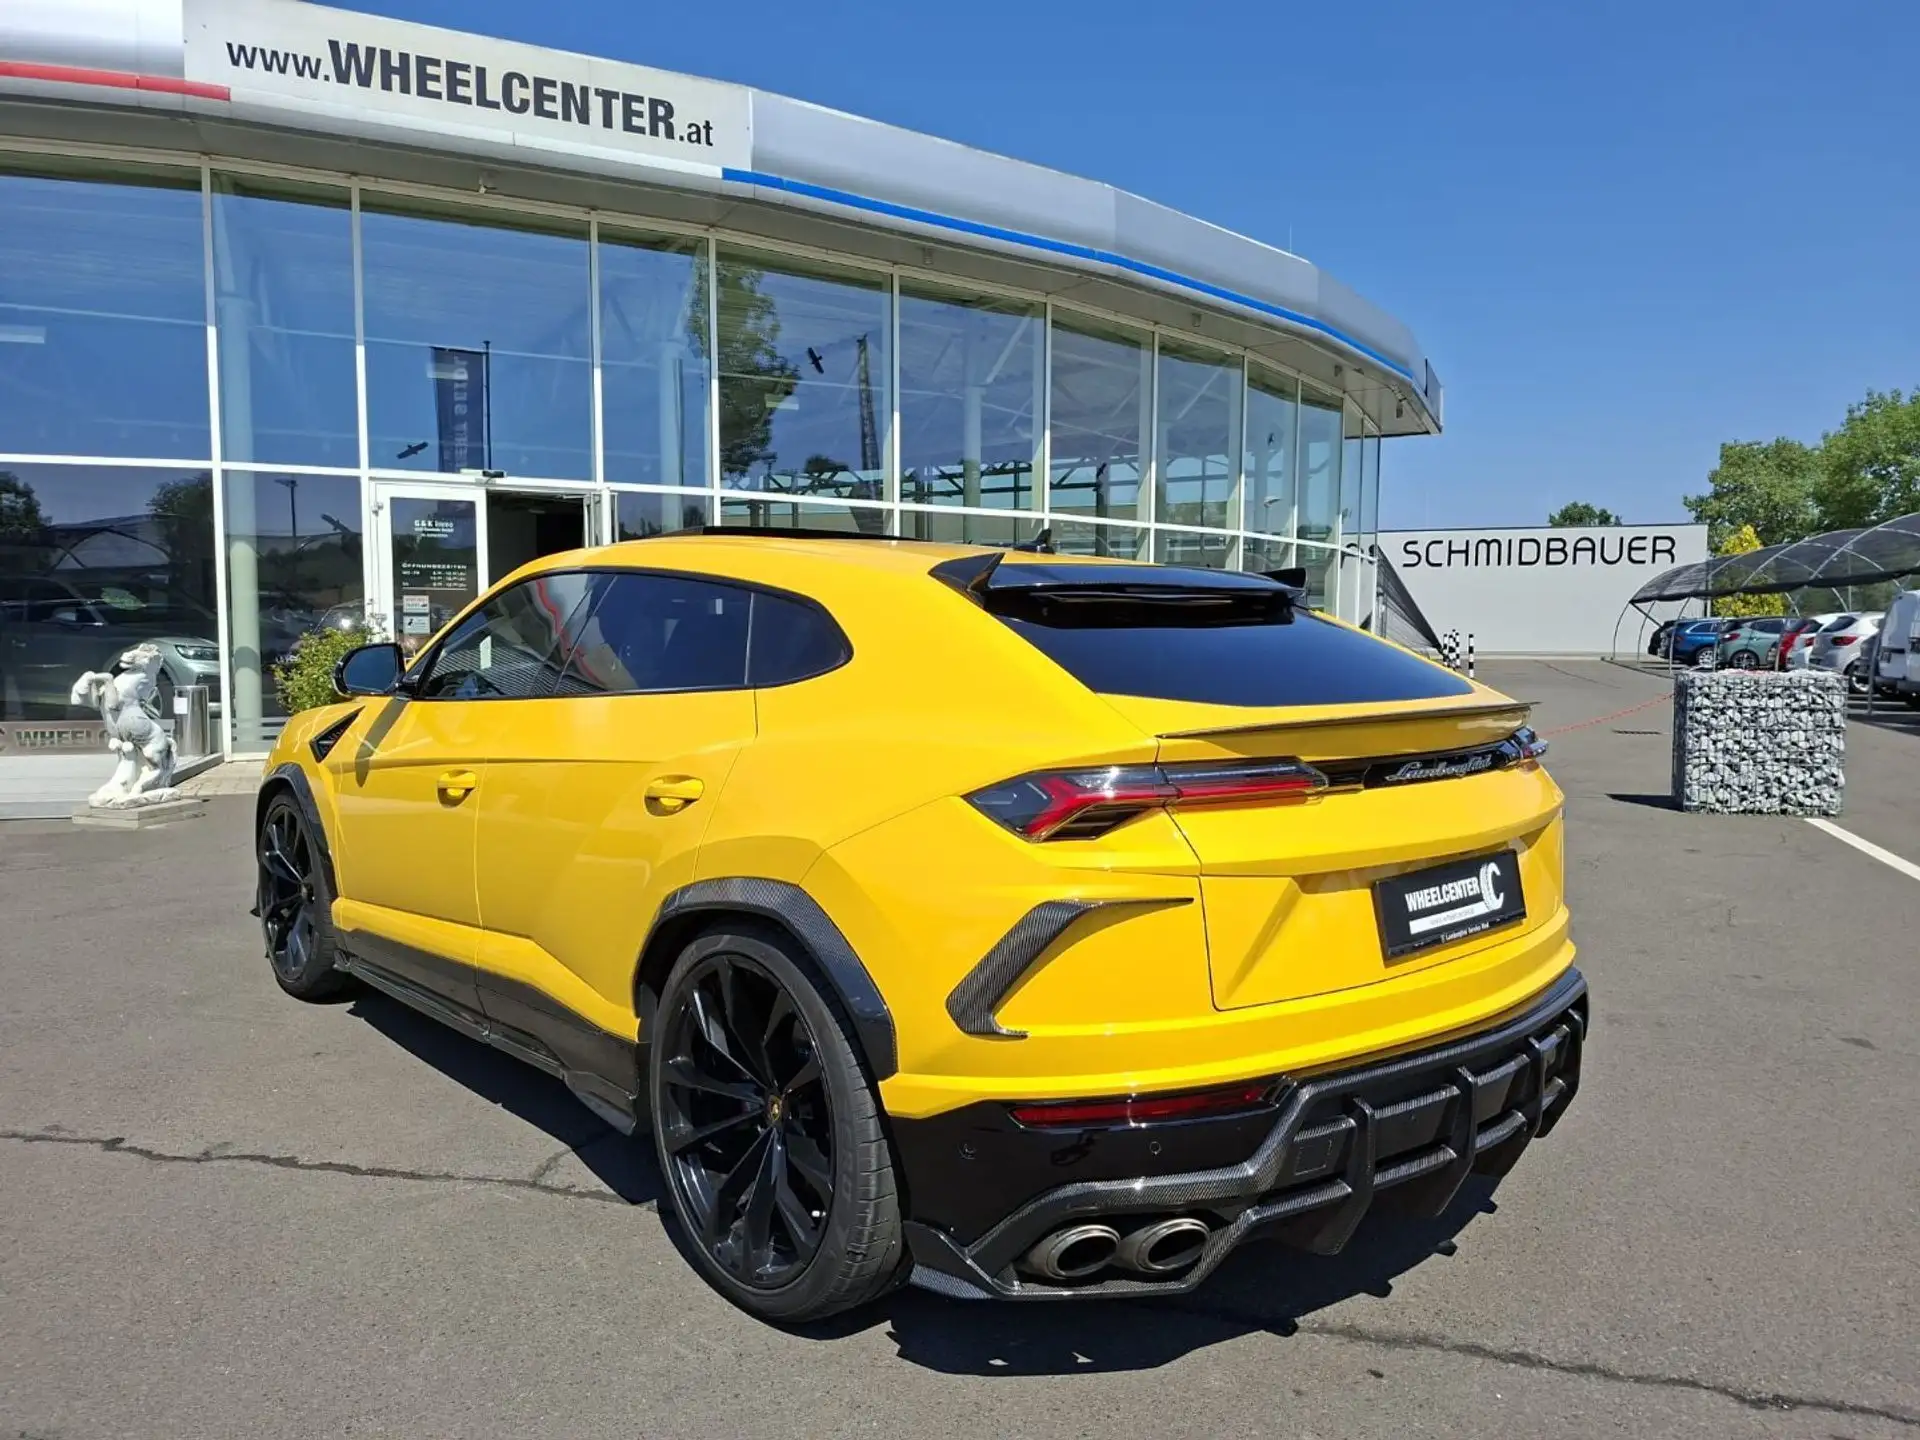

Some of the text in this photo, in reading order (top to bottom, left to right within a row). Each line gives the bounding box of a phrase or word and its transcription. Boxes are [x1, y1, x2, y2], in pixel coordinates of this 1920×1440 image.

[226, 39, 713, 147] www.WHEELCENTER.at
[1402, 536, 1676, 568] SCHMIDBAUER
[1405, 876, 1481, 912] WHEELCENTER
